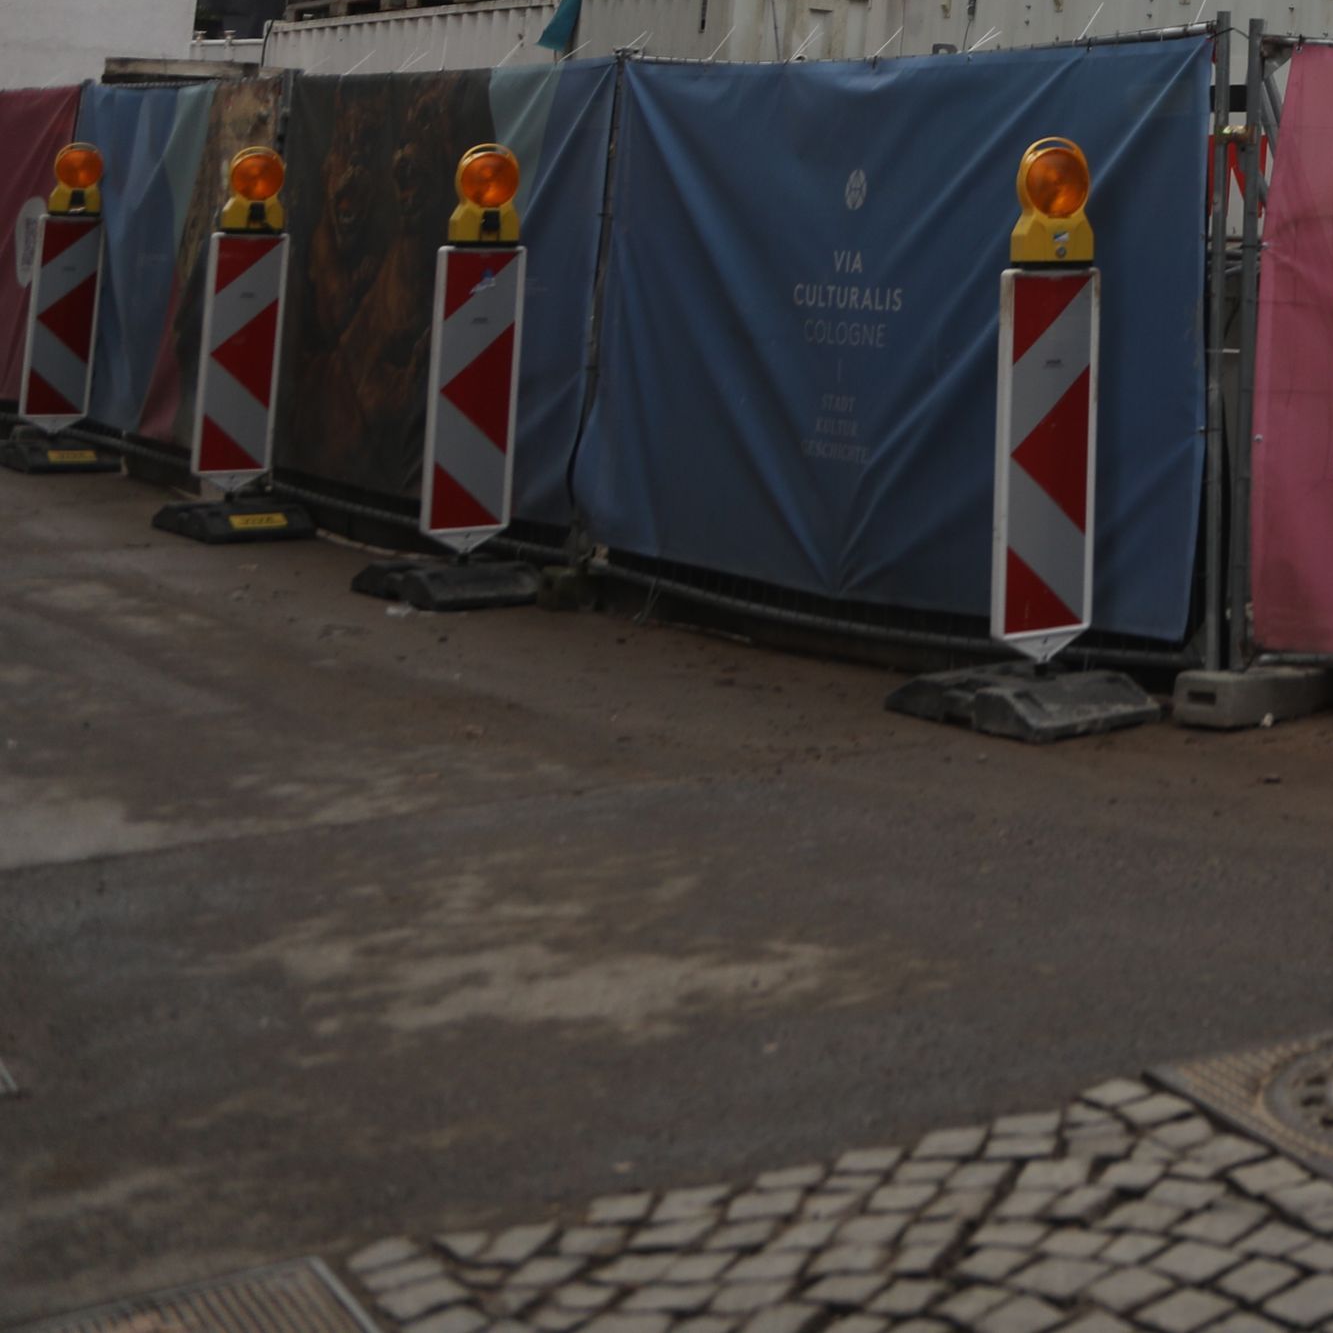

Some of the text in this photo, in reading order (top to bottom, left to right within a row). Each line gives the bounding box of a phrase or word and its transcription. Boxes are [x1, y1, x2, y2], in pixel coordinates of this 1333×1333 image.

[833, 249, 864, 275] VIA
[793, 282, 904, 312] CULTURALIS
[803, 318, 888, 349] COLOGNE
